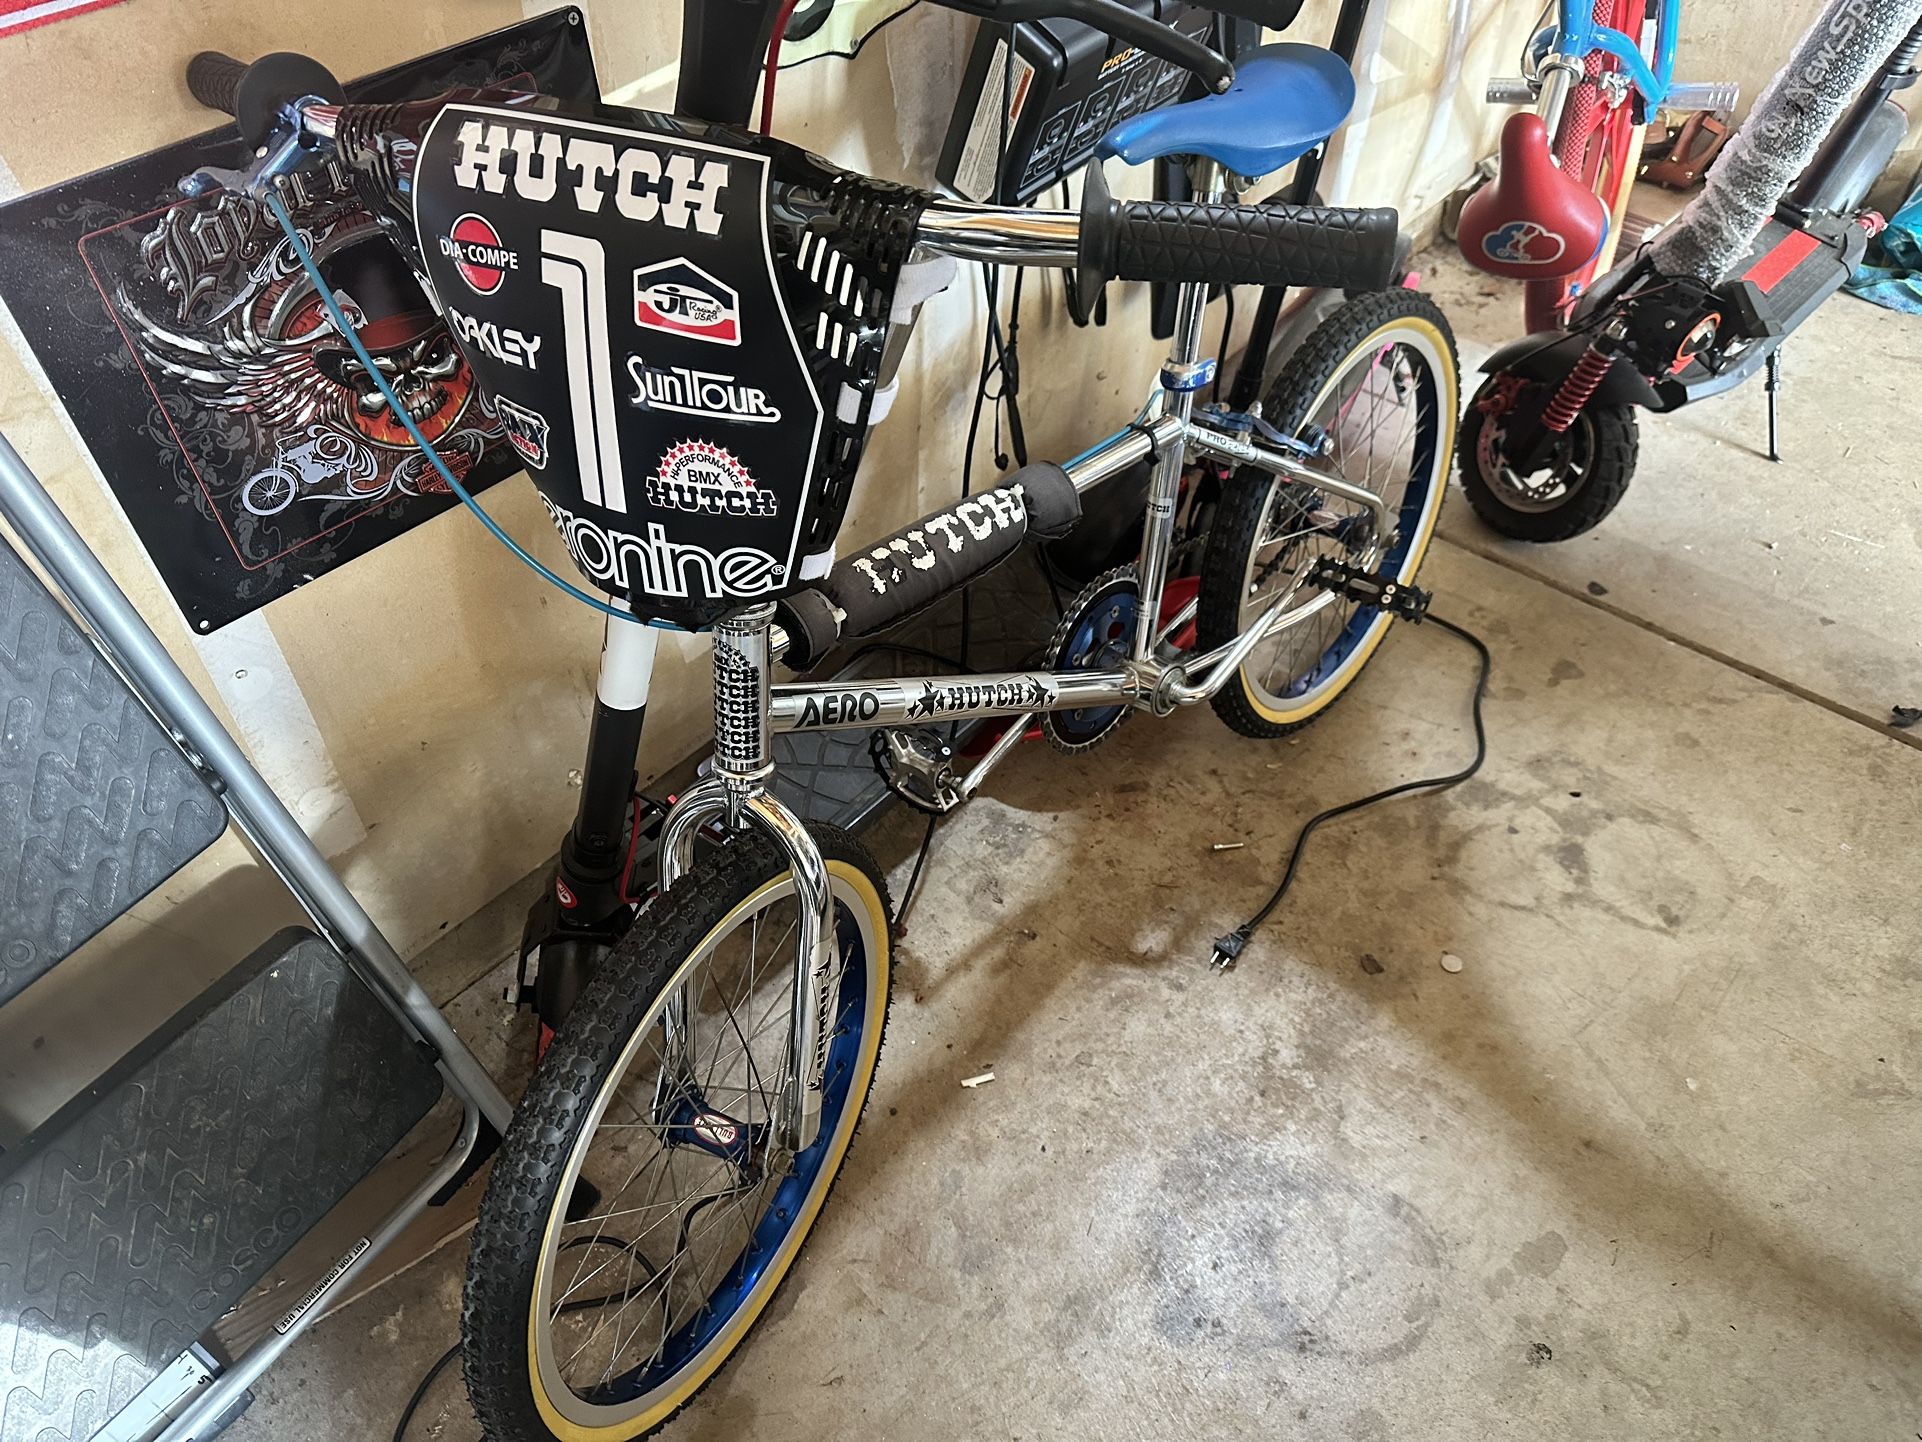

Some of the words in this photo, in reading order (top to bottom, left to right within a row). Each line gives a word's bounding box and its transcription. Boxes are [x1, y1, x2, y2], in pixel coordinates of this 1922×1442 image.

[454, 121, 729, 235] HUTCH
[439, 238, 519, 270] DIA-COMPE
[449, 306, 541, 370] OAKLEY
[541, 229, 627, 514] 1
[670, 453, 744, 489] HI-PERFORMANCE
[686, 468, 723, 486] BMX
[645, 476, 778, 516] HUTCH
[1147, 501, 1170, 513] TCH
[851, 483, 1026, 595] HUTCH
[713, 664, 760, 684] TCH
[713, 680, 760, 699] TCH
[947, 683, 1026, 711] HUTCH
[713, 696, 760, 715] TCH
[793, 691, 880, 729] AERO
[713, 711, 760, 730] TCH
[713, 727, 760, 746] TCH
[713, 742, 760, 760] TCH
[353, 1240, 367, 1256] NOT
[339, 1254, 354, 1270] FOR
[295, 1268, 340, 1314] COMMERCIAL
[280, 1312, 296, 1329] USE
